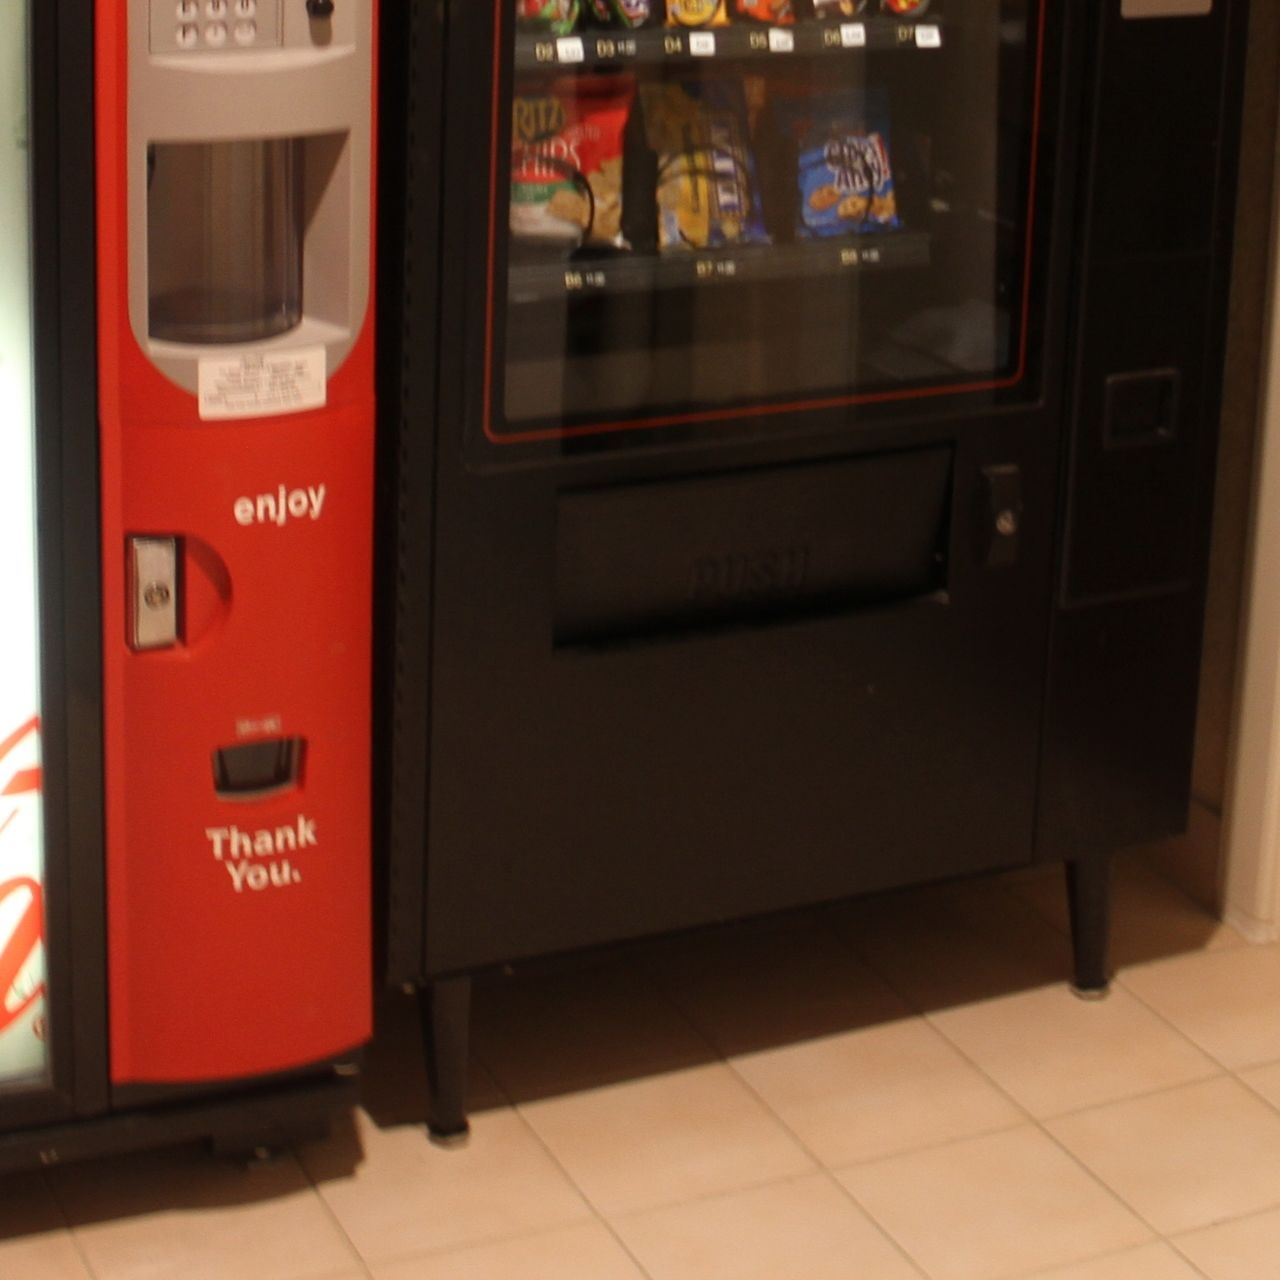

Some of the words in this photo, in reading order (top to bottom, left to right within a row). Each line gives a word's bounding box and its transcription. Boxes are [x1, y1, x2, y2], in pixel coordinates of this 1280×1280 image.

[232, 482, 327, 527] enjoy
[204, 812, 319, 861] Thank
[224, 858, 302, 894] You.
